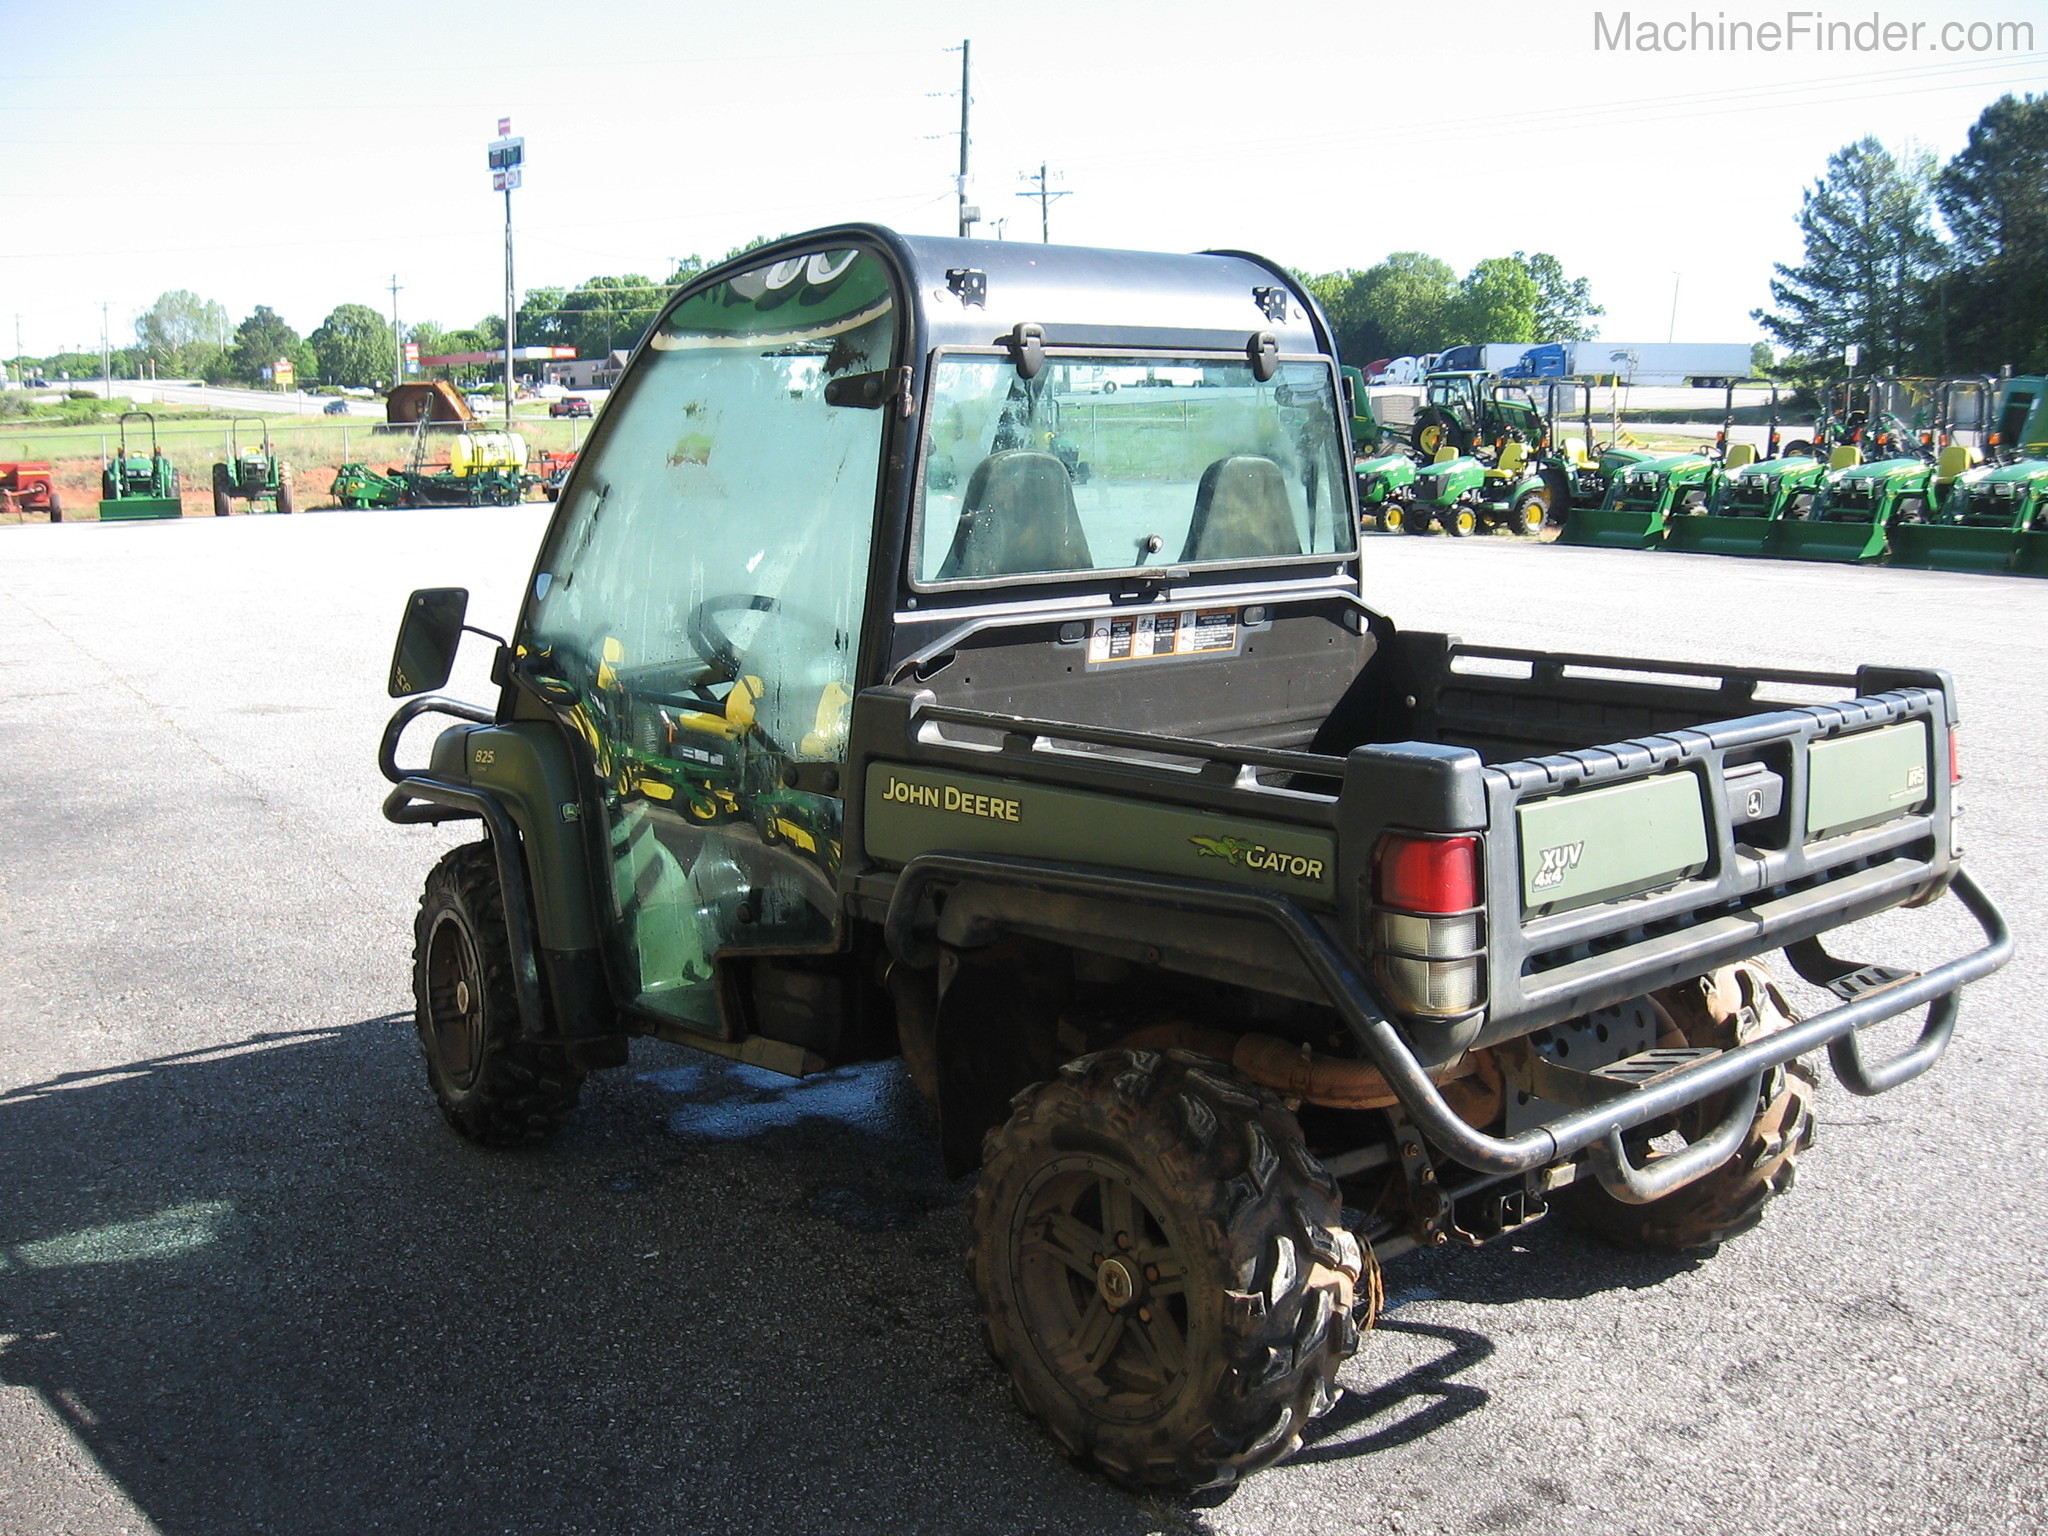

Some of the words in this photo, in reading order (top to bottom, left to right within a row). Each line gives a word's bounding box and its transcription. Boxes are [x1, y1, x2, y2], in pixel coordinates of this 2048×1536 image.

[883, 777, 939, 808] JOHN
[944, 786, 1019, 821] DEERE
[1246, 845, 1323, 879] GATOR
[1541, 842, 1583, 871] XUV
